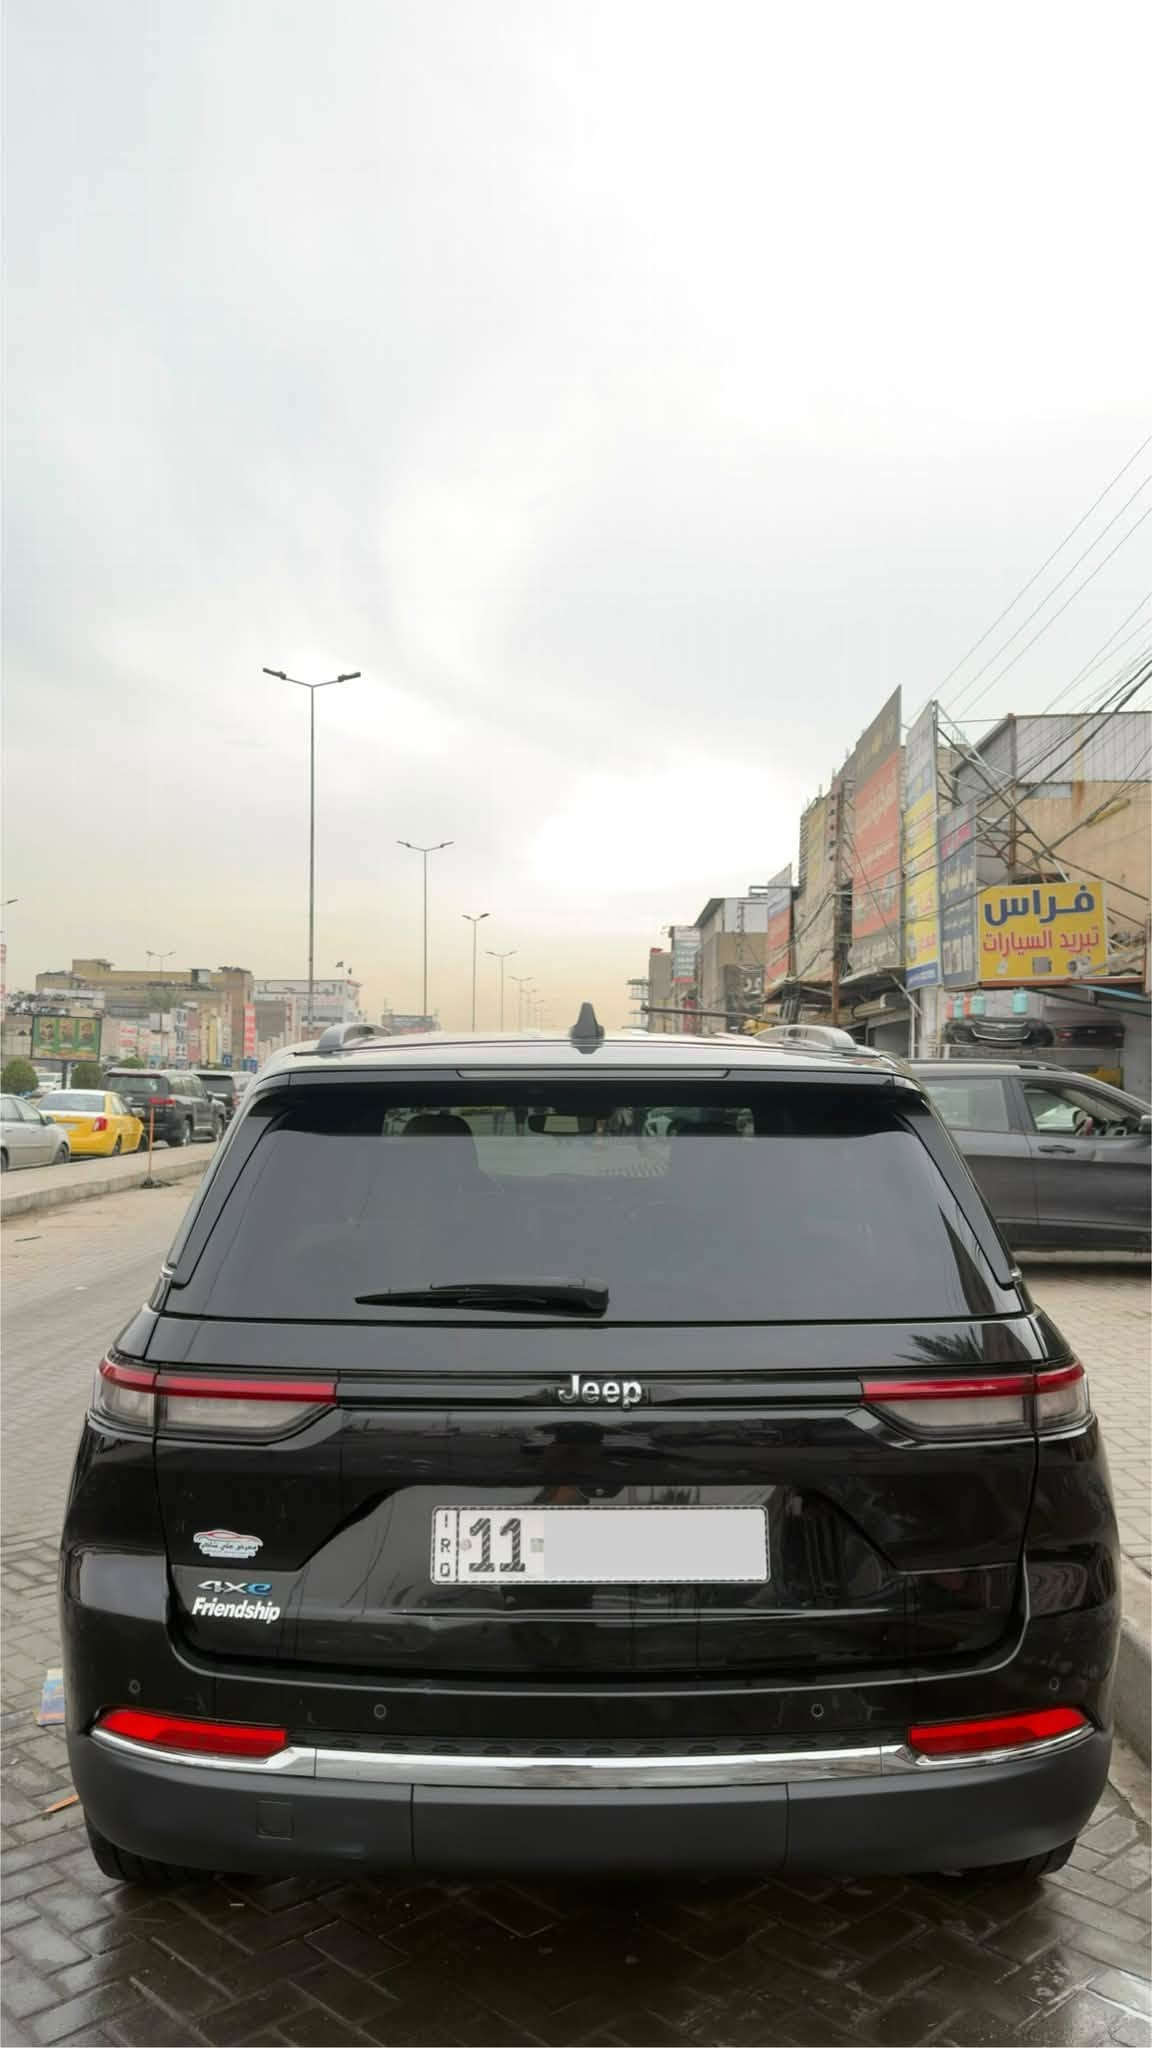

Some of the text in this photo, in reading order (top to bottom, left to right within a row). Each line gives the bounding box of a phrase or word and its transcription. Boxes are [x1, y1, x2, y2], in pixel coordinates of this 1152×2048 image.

[984, 885, 1095, 926] فراس
[983, 926, 1053, 958] السيارات
[1059, 924, 1100, 953] تبريد
[557, 1374, 642, 1409] Jeep
[468, 1517, 526, 1574] 11
[192, 1597, 281, 1624] Friendship
